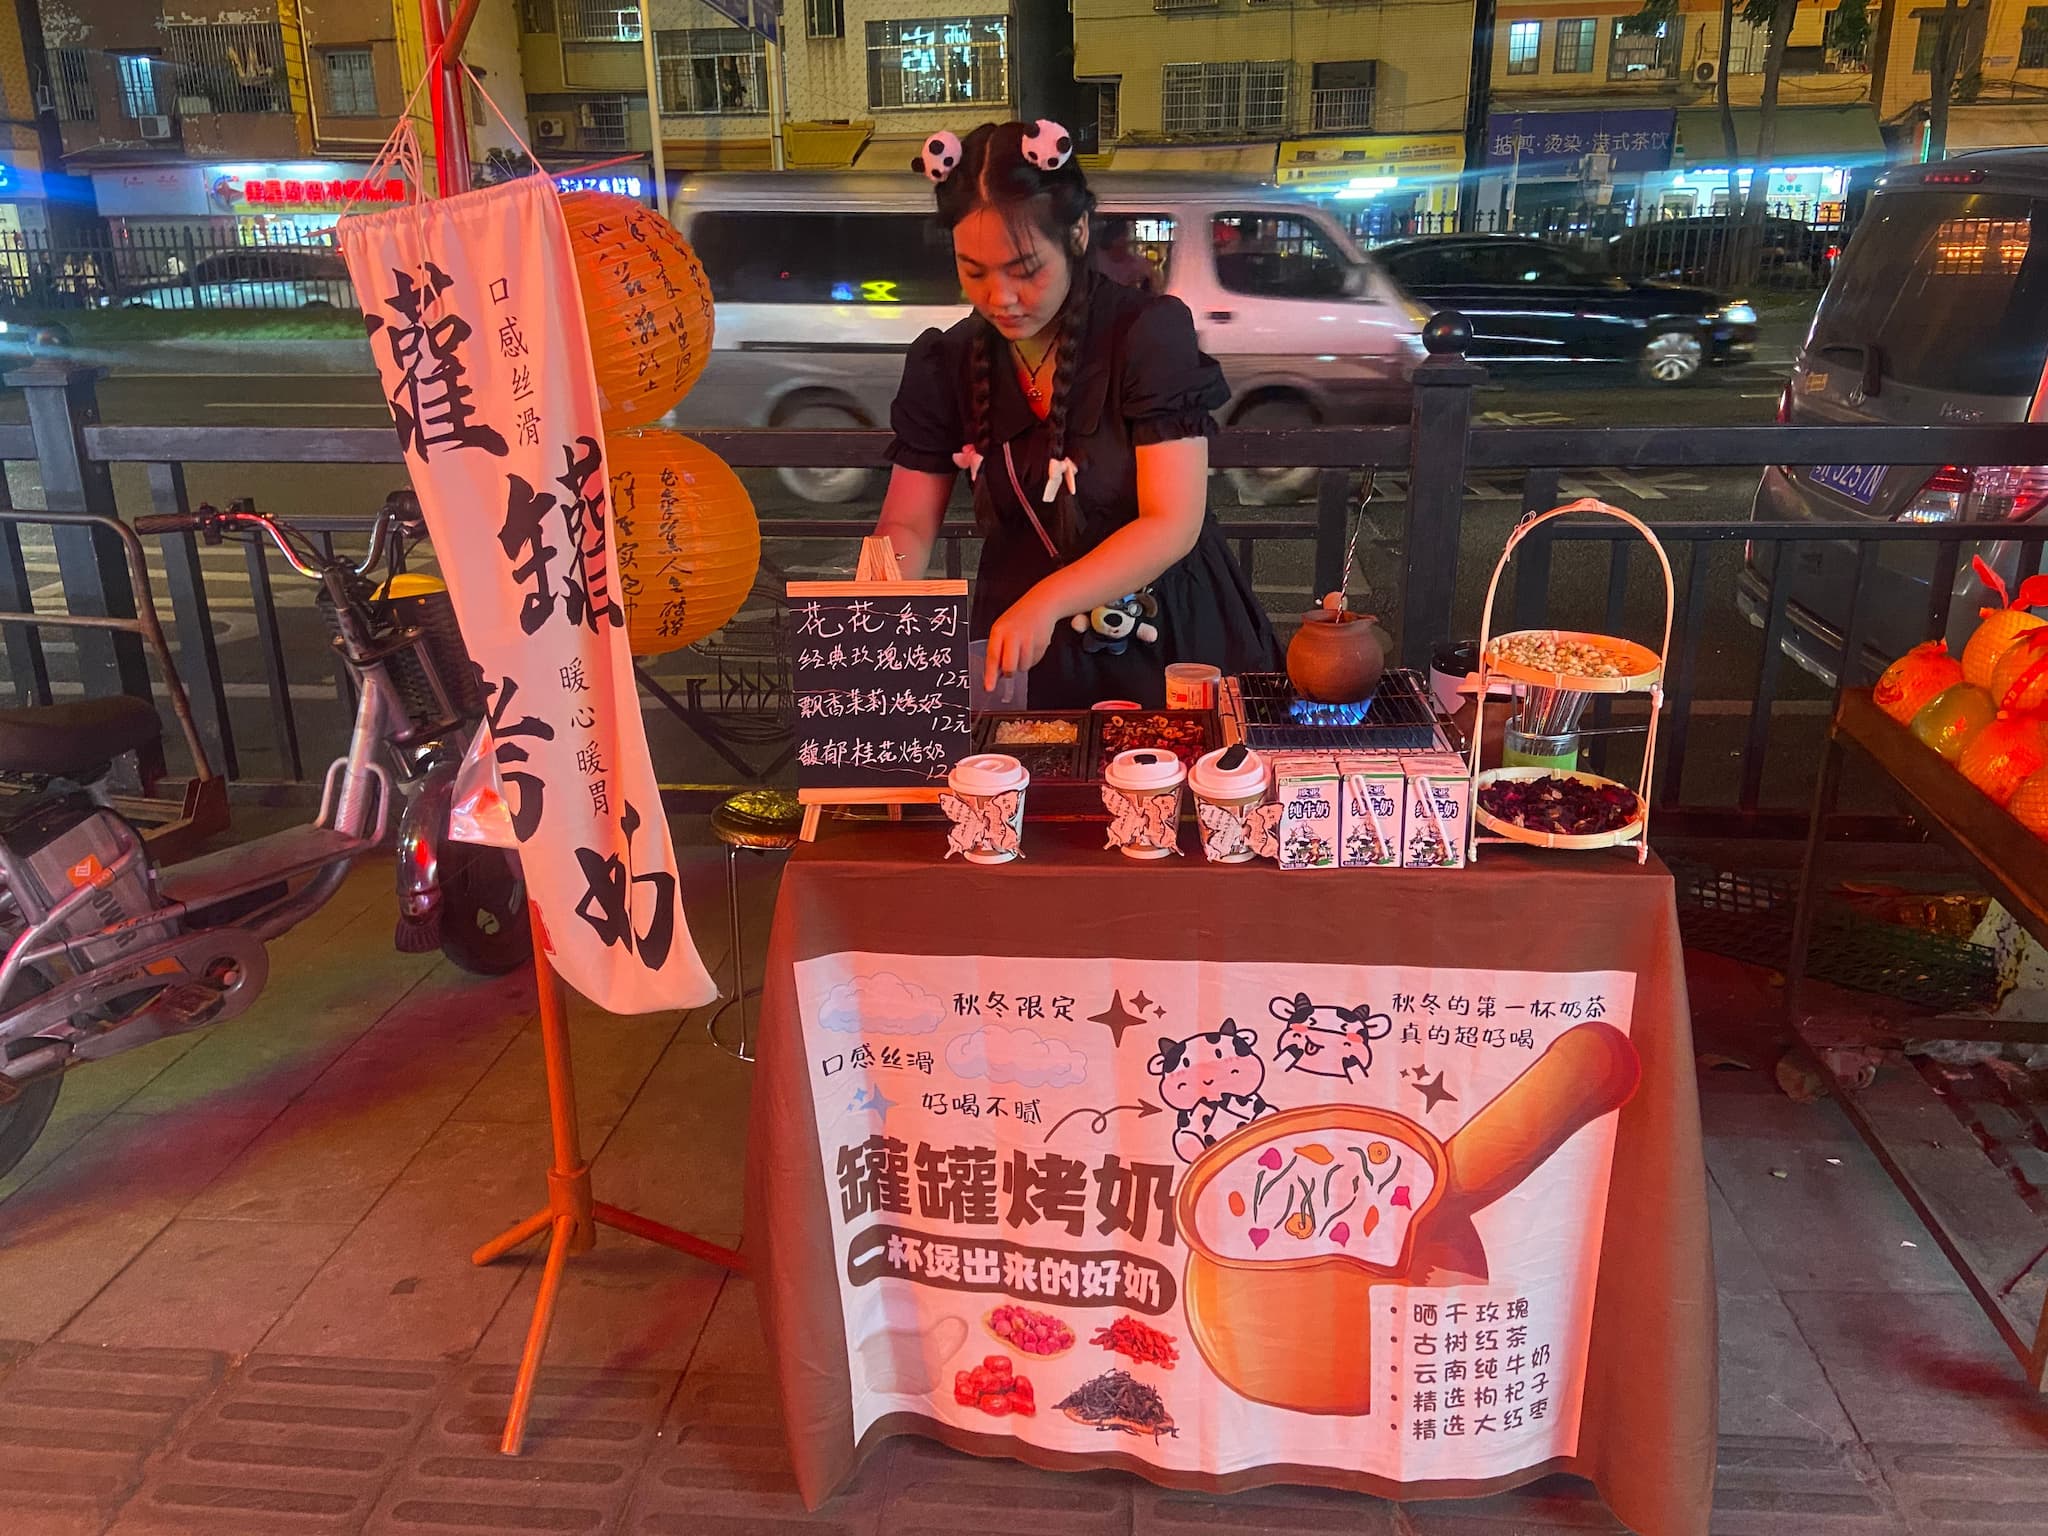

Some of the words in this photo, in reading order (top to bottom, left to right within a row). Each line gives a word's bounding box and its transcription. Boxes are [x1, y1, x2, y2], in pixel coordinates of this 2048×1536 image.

[489, 277, 542, 448] 口感丝滑
[797, 600, 958, 639] 花花系列
[797, 642, 952, 671] 经典玫瑰烤奶
[935, 669, 971, 689] 12元
[797, 688, 943, 718] 飘香茉莉烤奶
[559, 656, 610, 818] 暖心暖胃
[931, 714, 972, 734] 12元
[797, 737, 946, 768] 馥郁桂花烤奶
[1288, 800, 1331, 819] 纯牛奶
[953, 991, 1076, 1022] 秋冬限定
[1391, 992, 1607, 1019] 秋冬的第一杯奶茶
[1399, 1022, 1535, 1049] 真的超好喝
[821, 1044, 935, 1076] 口感丝滑
[921, 1092, 1042, 1124] 好喝不腻
[837, 1134, 1178, 1247] 罐罐烤奶
[853, 1234, 1160, 1307] 一杯煲出来的好奶
[1413, 1297, 1529, 1326] 晒干玫瑰
[1413, 1326, 1528, 1356] 古树红茶
[1413, 1343, 1551, 1384] 云南纯牛奶
[1412, 1372, 1549, 1413] 精选枸杞子
[1412, 1397, 1549, 1441] 精选大红枣
